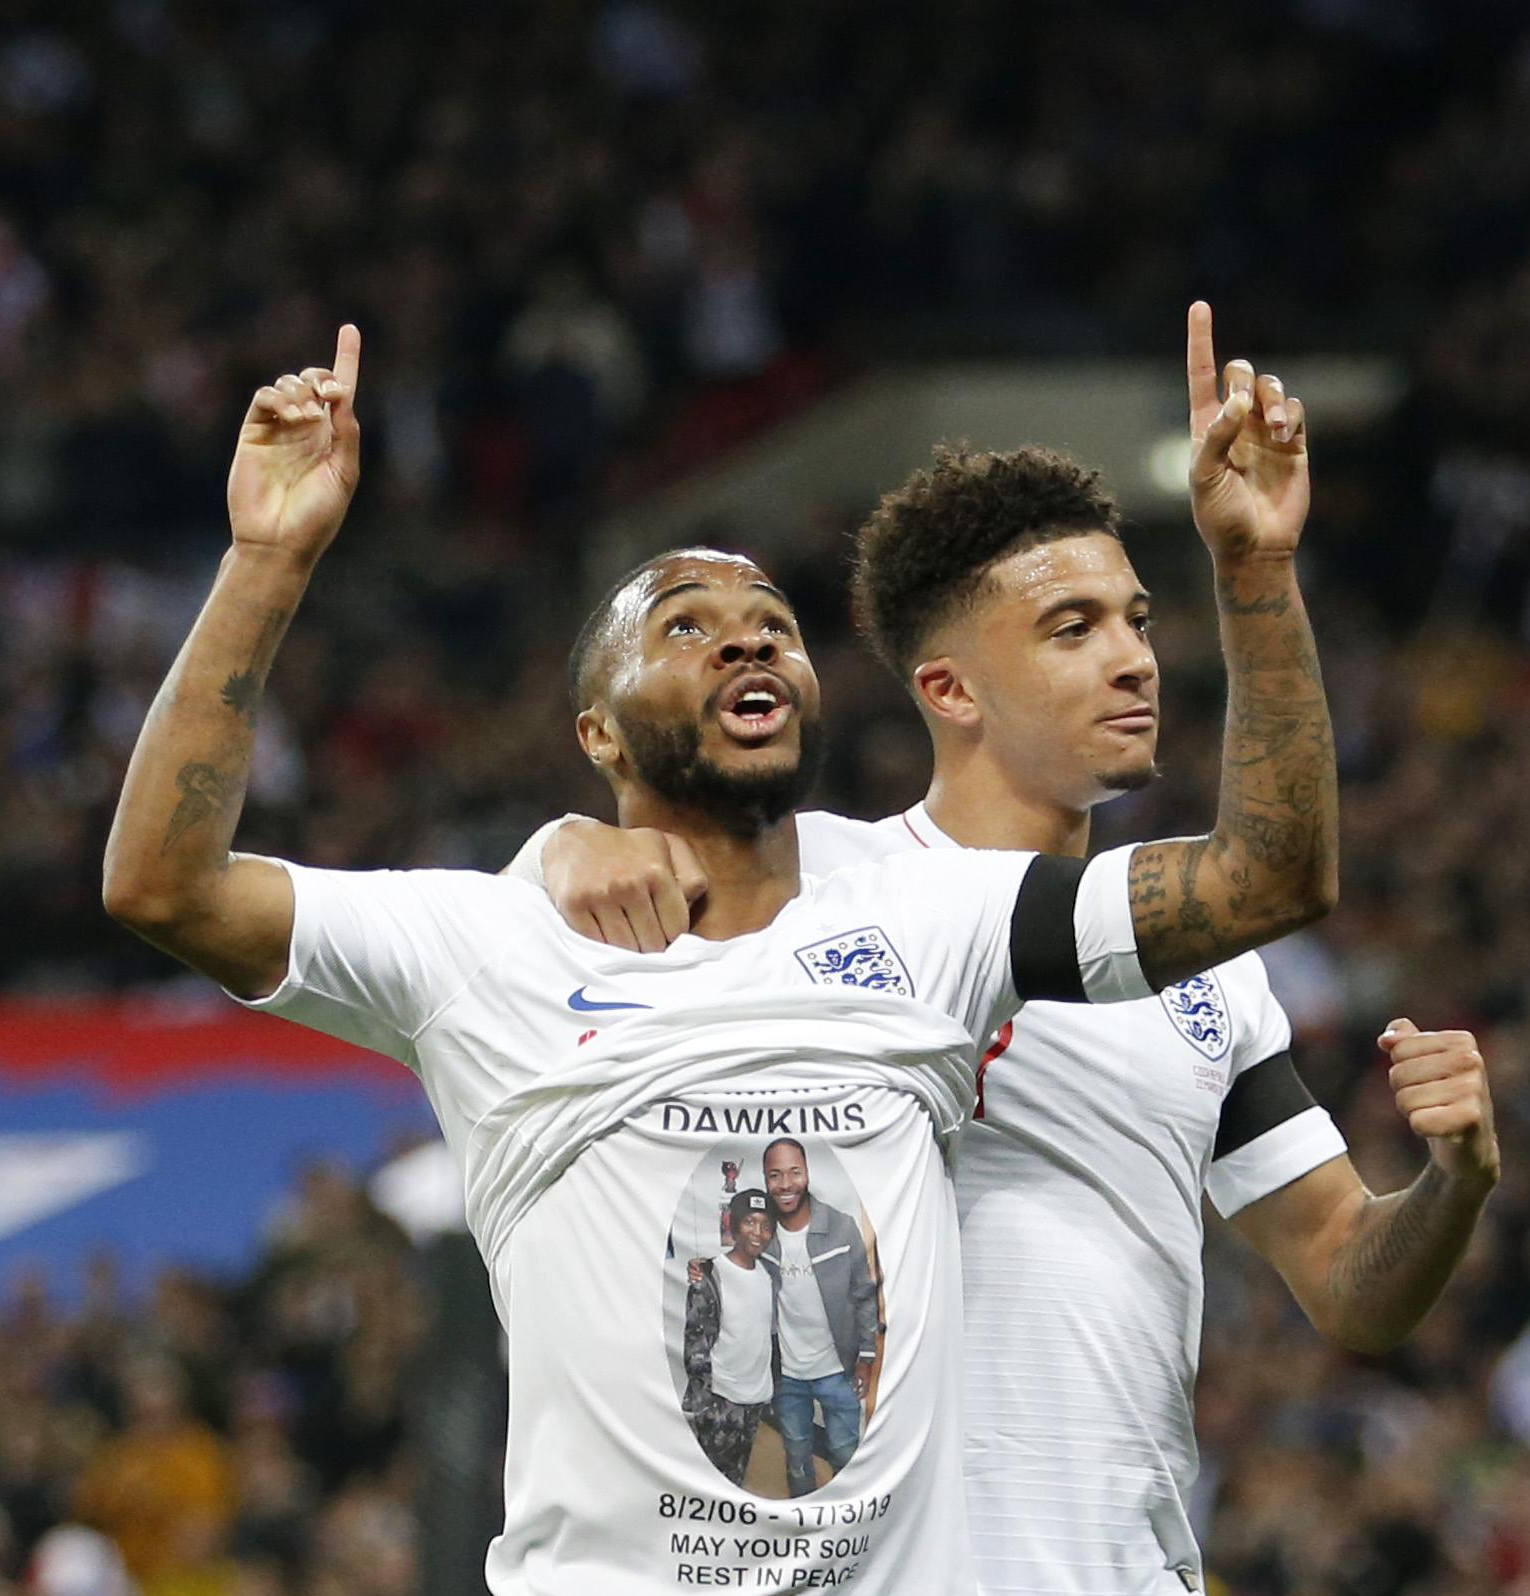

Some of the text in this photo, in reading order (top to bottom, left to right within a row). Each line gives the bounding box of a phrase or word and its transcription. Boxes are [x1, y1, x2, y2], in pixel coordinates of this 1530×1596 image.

[662, 1103, 866, 1134] DAWKINS
[658, 1493, 758, 1525] 8/2/06
[790, 1494, 892, 1527] 17/3/19
[670, 1533, 870, 1559] MAY YOUR SOUL
[676, 1562, 749, 1587] REST
[756, 1566, 783, 1587] IN
